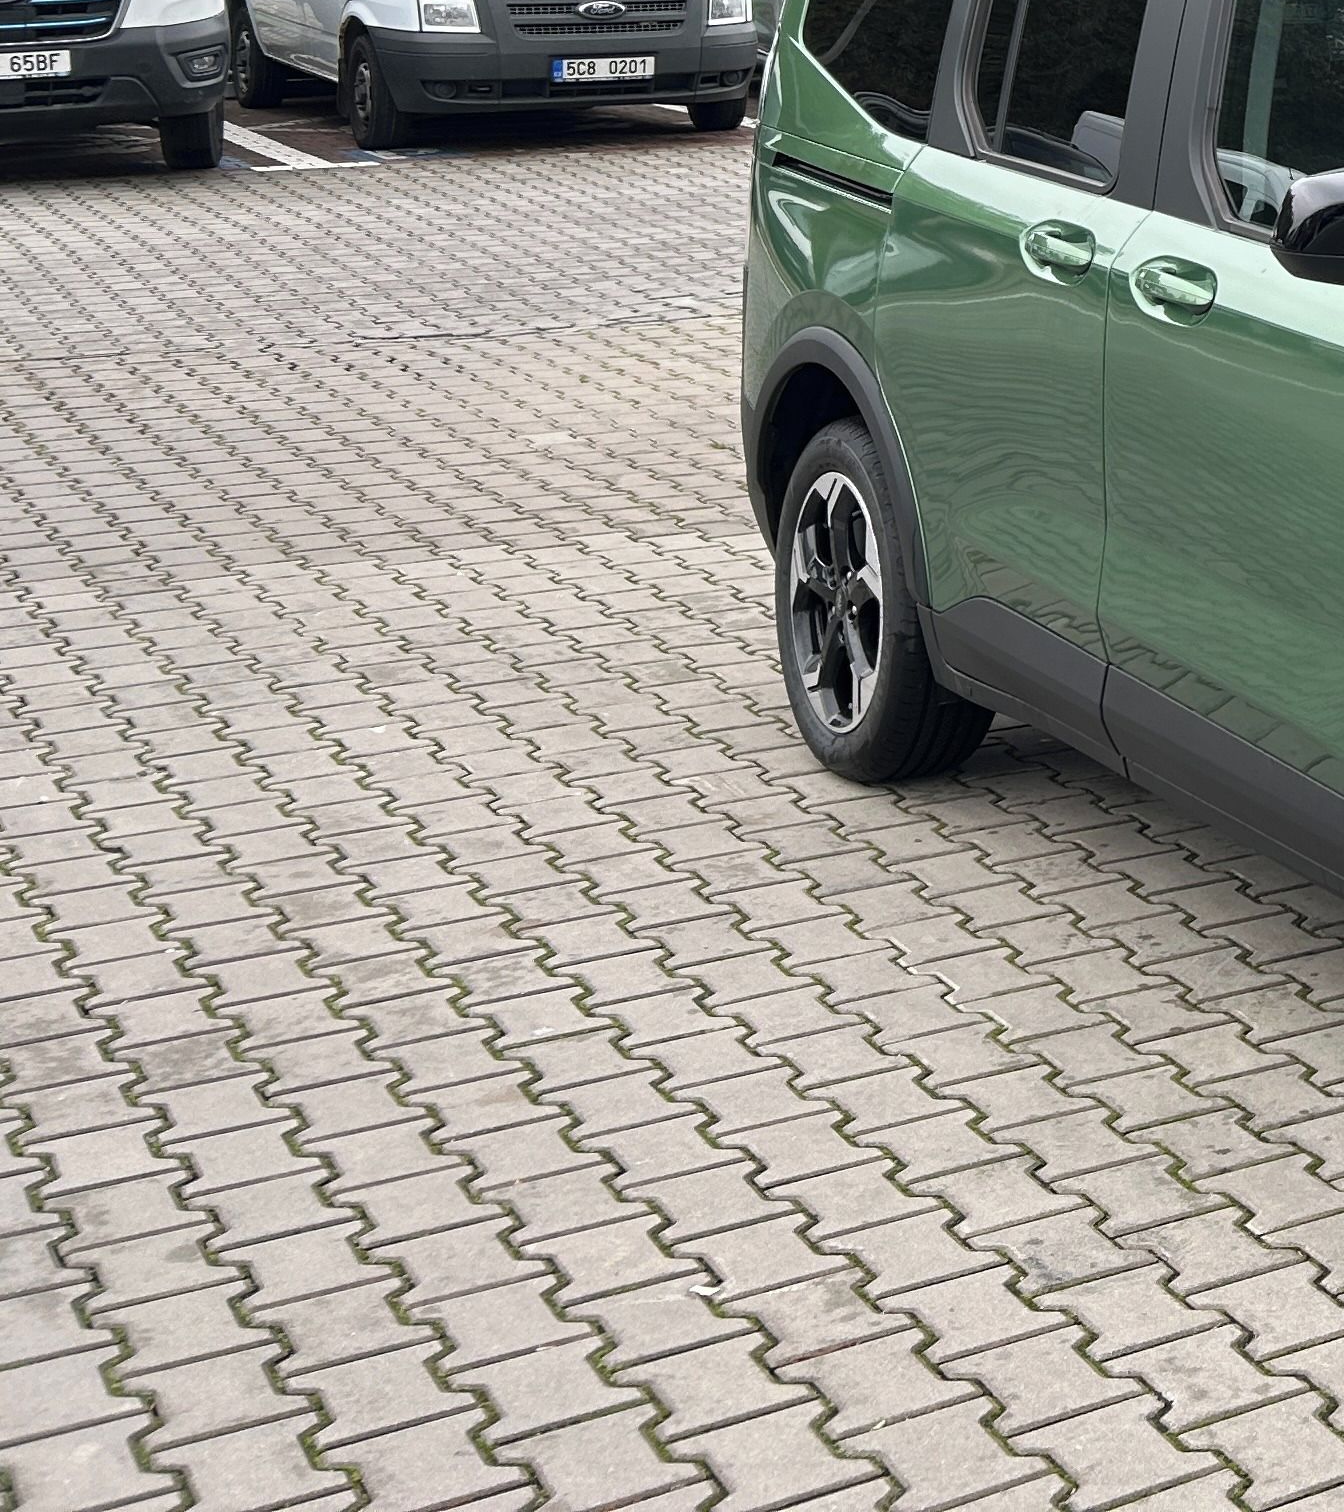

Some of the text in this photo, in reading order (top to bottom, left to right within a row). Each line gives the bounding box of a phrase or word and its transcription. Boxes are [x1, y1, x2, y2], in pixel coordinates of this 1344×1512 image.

[10, 53, 60, 72] 65BF
[567, 59, 647, 76] 5C8 0201
